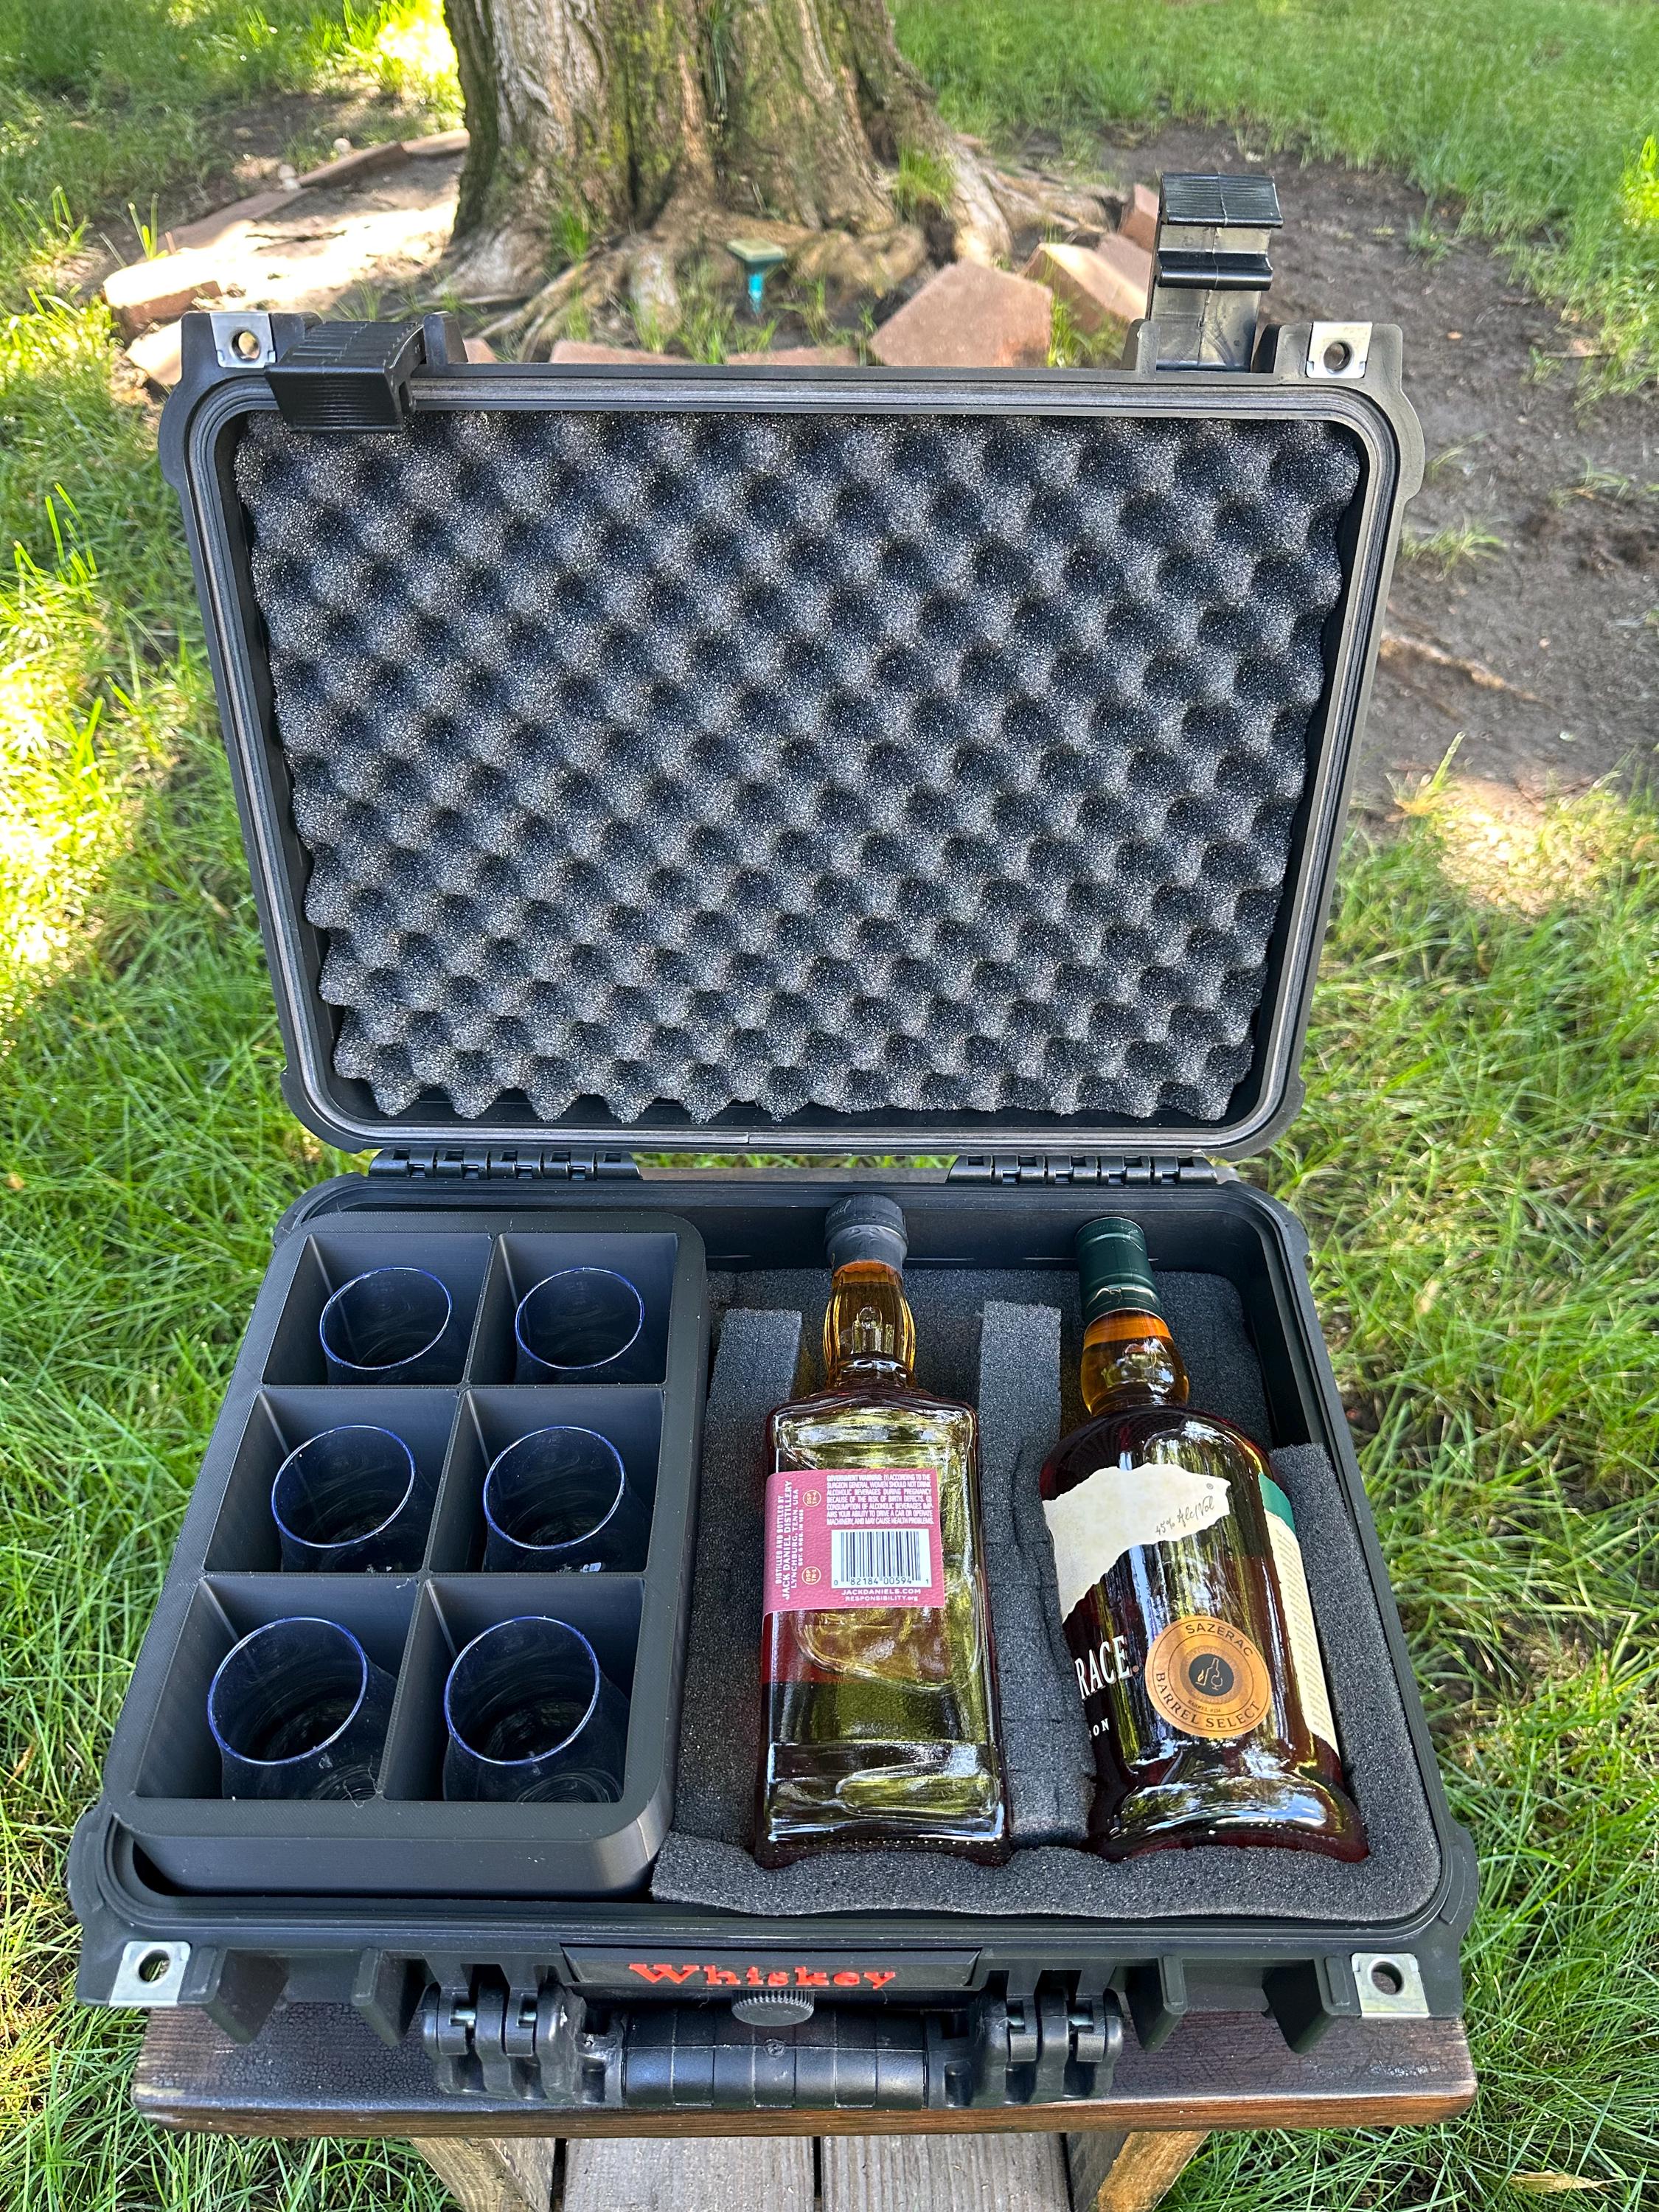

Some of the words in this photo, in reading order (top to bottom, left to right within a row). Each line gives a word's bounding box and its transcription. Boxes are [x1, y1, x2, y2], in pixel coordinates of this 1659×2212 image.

[777, 1495, 785, 1503] BY
[784, 1480, 793, 1534] DISTILLERY
[776, 1505, 785, 1534] BOTTLED
[1155, 1517, 1176, 1536] 45%
[776, 1534, 784, 1549] AND
[782, 1534, 791, 1571] DANIEL
[775, 1551, 783, 1585] DISTILLED
[782, 1573, 790, 1601] JACK
[1185, 1623, 1253, 1657] SAZERAC
[1155, 1672, 1199, 1725] BARREL
[1206, 1701, 1261, 1728] SELECT
[629, 1964, 896, 1989] Whiskey
